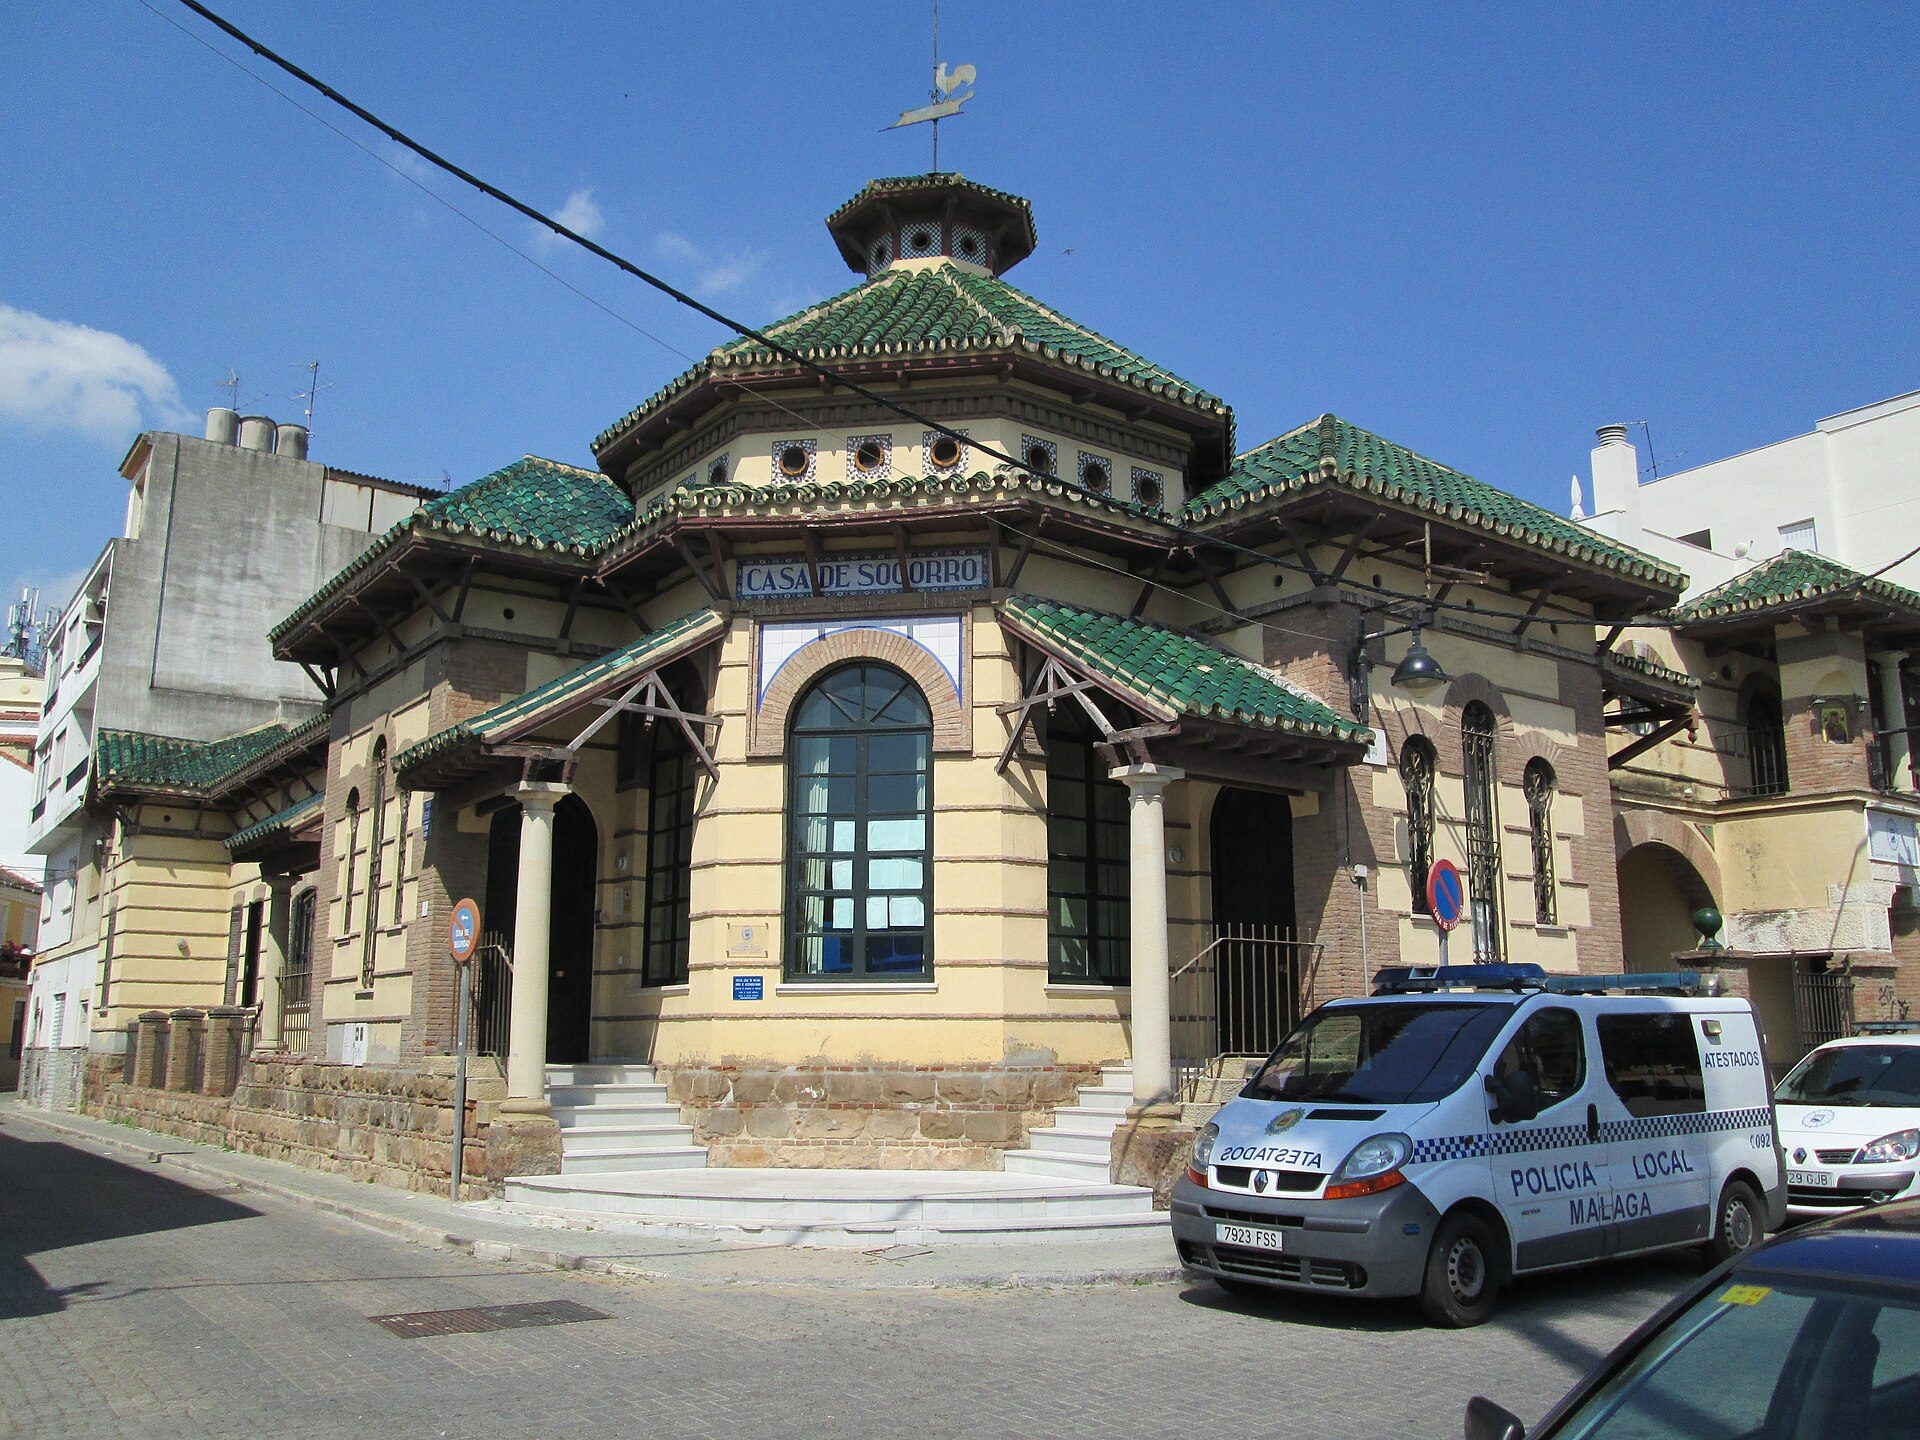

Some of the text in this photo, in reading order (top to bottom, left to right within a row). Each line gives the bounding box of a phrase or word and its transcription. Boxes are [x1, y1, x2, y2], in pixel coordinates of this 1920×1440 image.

[746, 558, 978, 592] CASA DE SOCORRO
[1704, 1051, 1760, 1069] ATESTADOS
[1755, 1133, 1771, 1149] 092
[1510, 1149, 1694, 1197] POLICIA LOCAL
[1806, 1174, 1828, 1186] GJB
[1569, 1191, 1653, 1226] MALAGA
[1224, 1226, 1277, 1248] 7923 FSS
